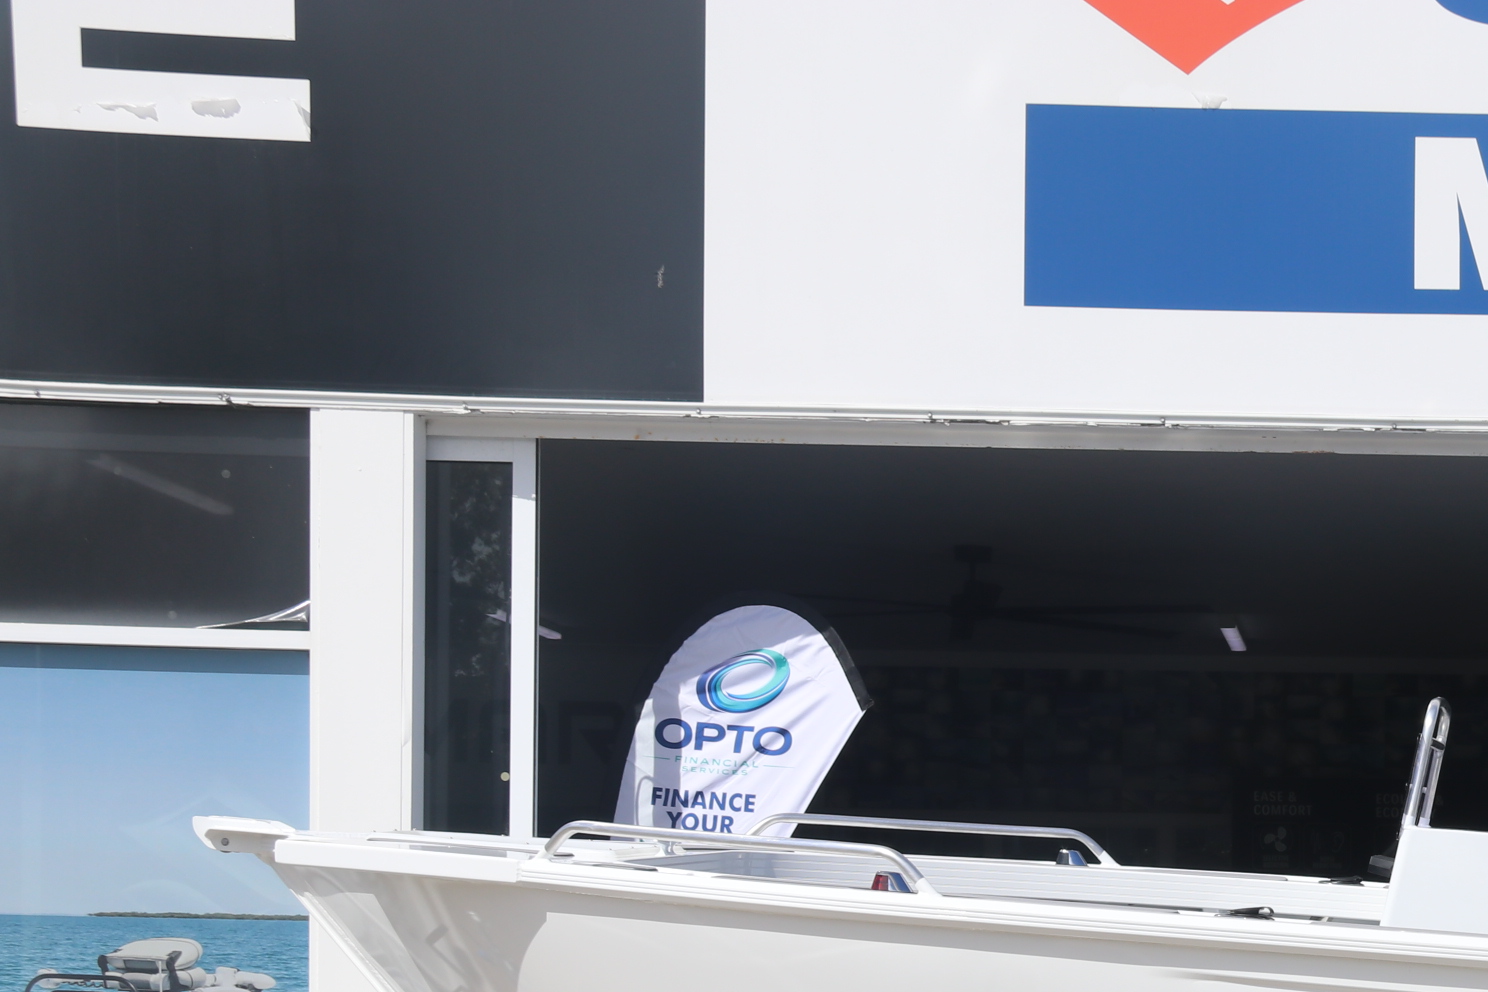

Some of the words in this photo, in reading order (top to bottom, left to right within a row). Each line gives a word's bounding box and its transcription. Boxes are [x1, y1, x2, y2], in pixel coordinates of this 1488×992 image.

[654, 717, 793, 757] OPTO
[674, 755, 759, 768] FINANCIAL
[682, 766, 749, 776] SERVICES
[650, 786, 757, 813] FINANCE
[1253, 790, 1283, 803] EASE
[1253, 804, 1313, 817] COMFORT
[666, 811, 734, 834] YOUR
